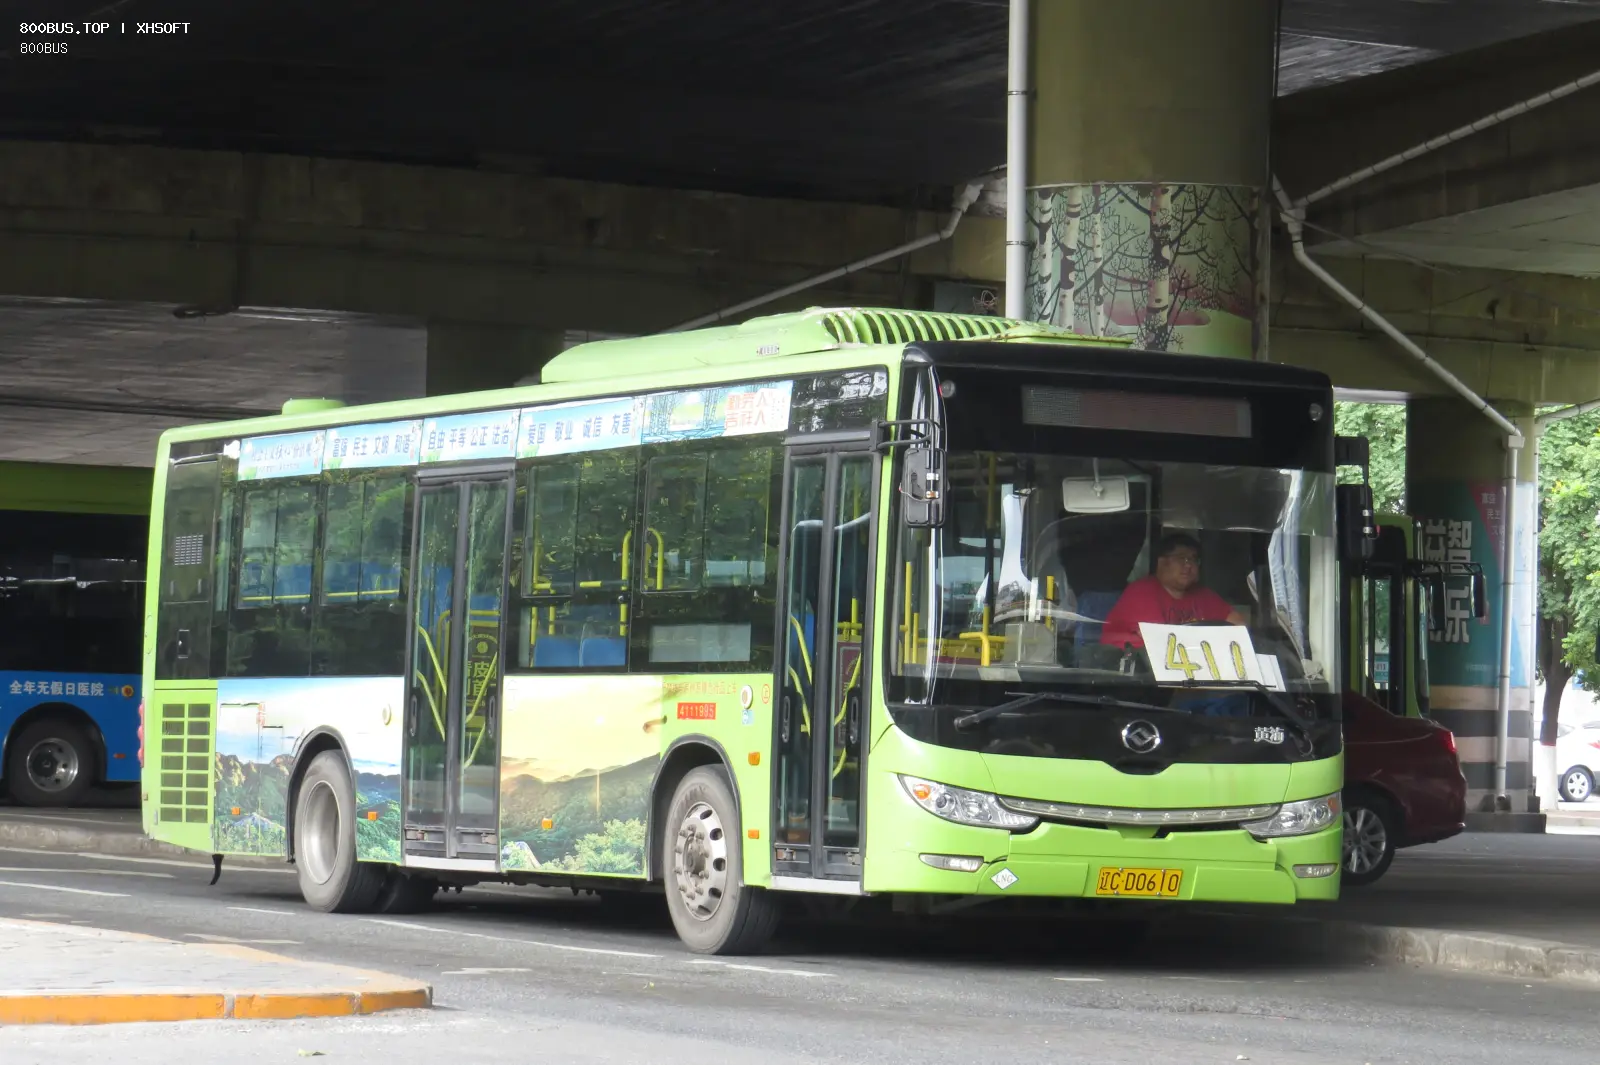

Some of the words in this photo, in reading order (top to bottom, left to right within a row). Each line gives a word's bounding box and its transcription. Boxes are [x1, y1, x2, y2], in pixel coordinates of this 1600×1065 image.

[428, 430, 446, 449] 自由
[449, 428, 467, 448] 平等
[470, 426, 488, 447] 公正
[491, 424, 510, 445] 法治
[527, 423, 547, 445] 爱国
[554, 420, 573, 442] 敬业
[582, 417, 603, 438] 诚信
[610, 412, 632, 435] 友善
[1165, 632, 1247, 680] 411
[9, 680, 105, 697] 全年无假日医院
[996, 873, 1013, 883] LNG
